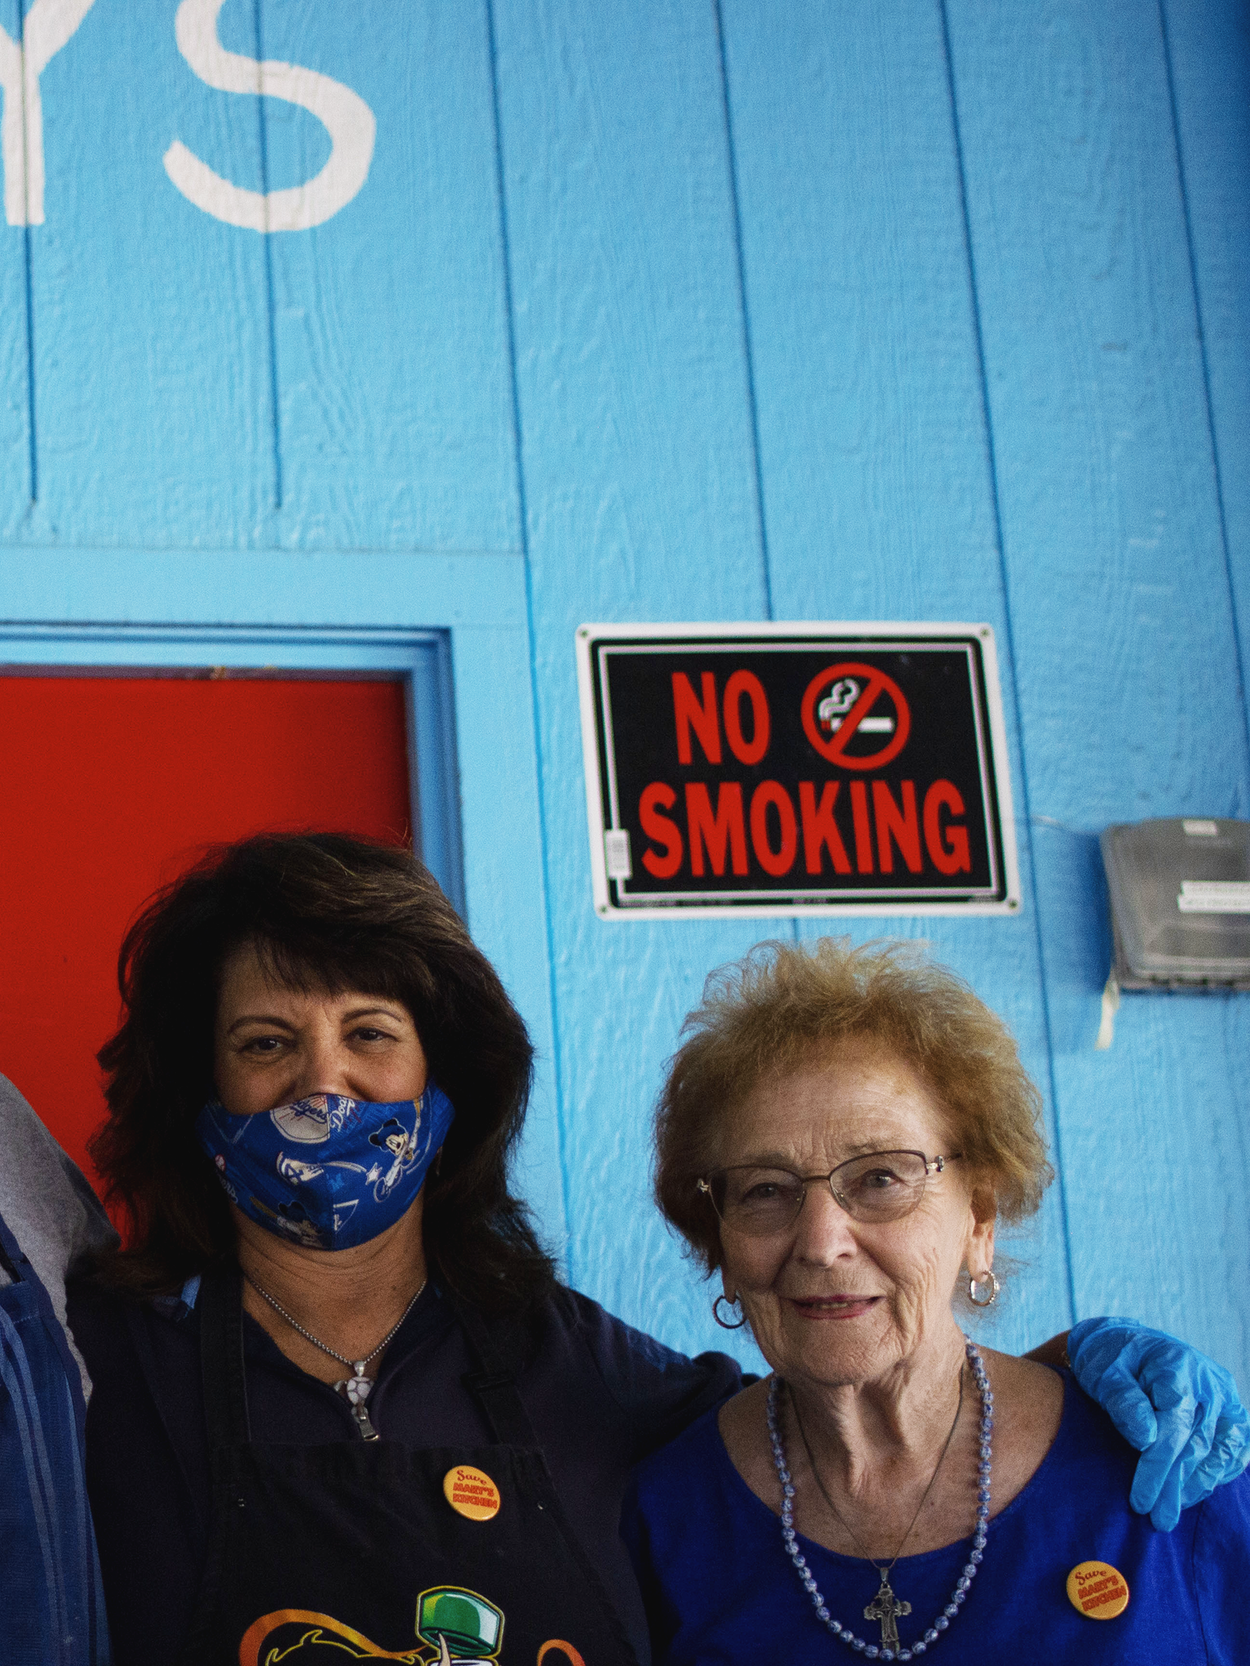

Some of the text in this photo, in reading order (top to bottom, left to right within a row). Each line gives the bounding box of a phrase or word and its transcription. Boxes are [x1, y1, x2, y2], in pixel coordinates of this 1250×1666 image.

[671, 669, 771, 765] NO
[638, 779, 972, 878] SMOKING
[456, 1469, 487, 1485] Save
[453, 1482, 495, 1497] MARY'S
[452, 1493, 498, 1509] KITCHEN
[1075, 1570, 1107, 1586] Save
[1078, 1575, 1118, 1599] MARY'S
[1081, 1585, 1127, 1612] KITCHEN
